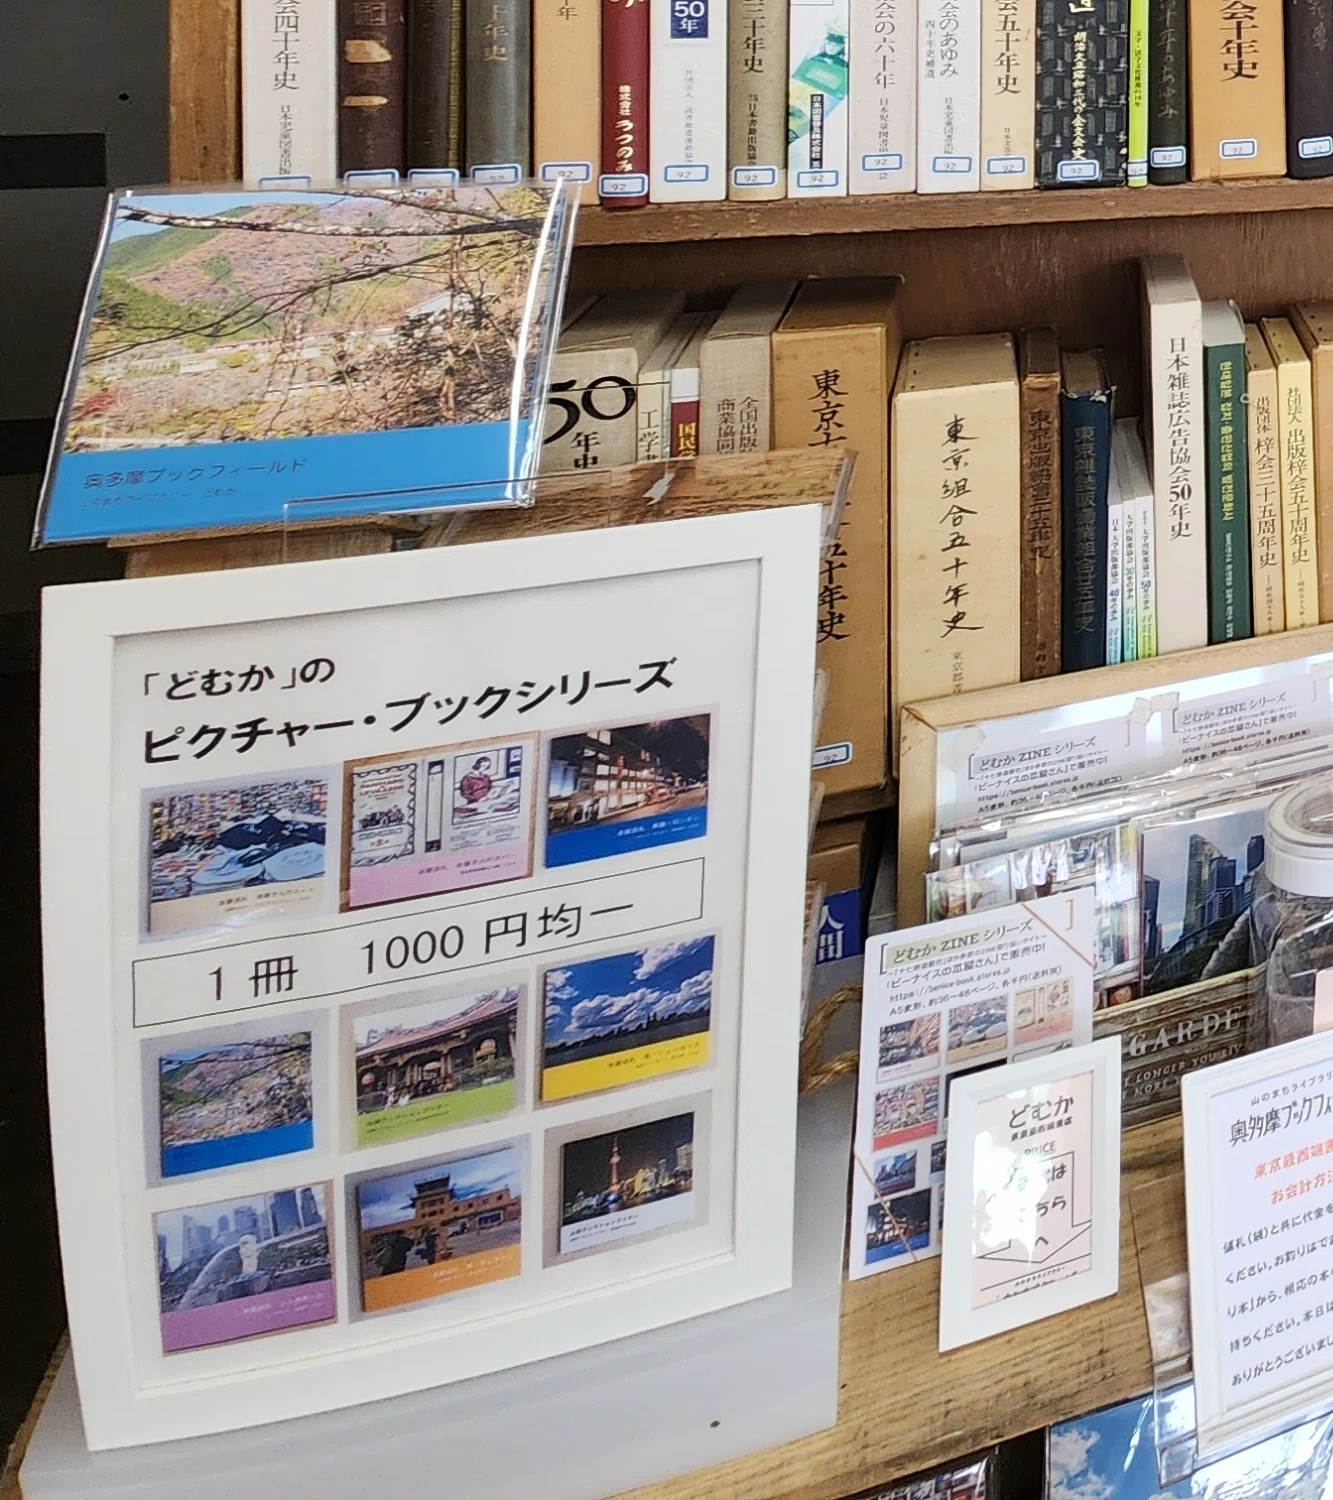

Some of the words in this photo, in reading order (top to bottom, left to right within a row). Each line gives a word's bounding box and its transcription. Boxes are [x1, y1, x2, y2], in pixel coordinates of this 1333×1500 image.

[1166, 337, 1194, 542] 日本雑誌広告協会50年史
[938, 412, 985, 639] 東京組合五十年史
[1253, 436, 1279, 568] 梓会三十五周年史
[1286, 428, 1311, 565] 出版梓会五十周年史
[142, 656, 338, 700] 「どむか」の
[143, 655, 678, 764] ピクチャー・ブックシリーズ
[1180, 708, 1215, 726] どむか
[1216, 702, 1248, 718] ZINE
[1249, 691, 1288, 712] シリーズ
[978, 754, 1016, 773] どむか
[1018, 746, 1052, 764] ZINE
[1054, 735, 1098, 756] シリーズ
[892, 945, 937, 965] どむか
[940, 933, 981, 952] ZINE
[983, 918, 1035, 941] シリーズ
